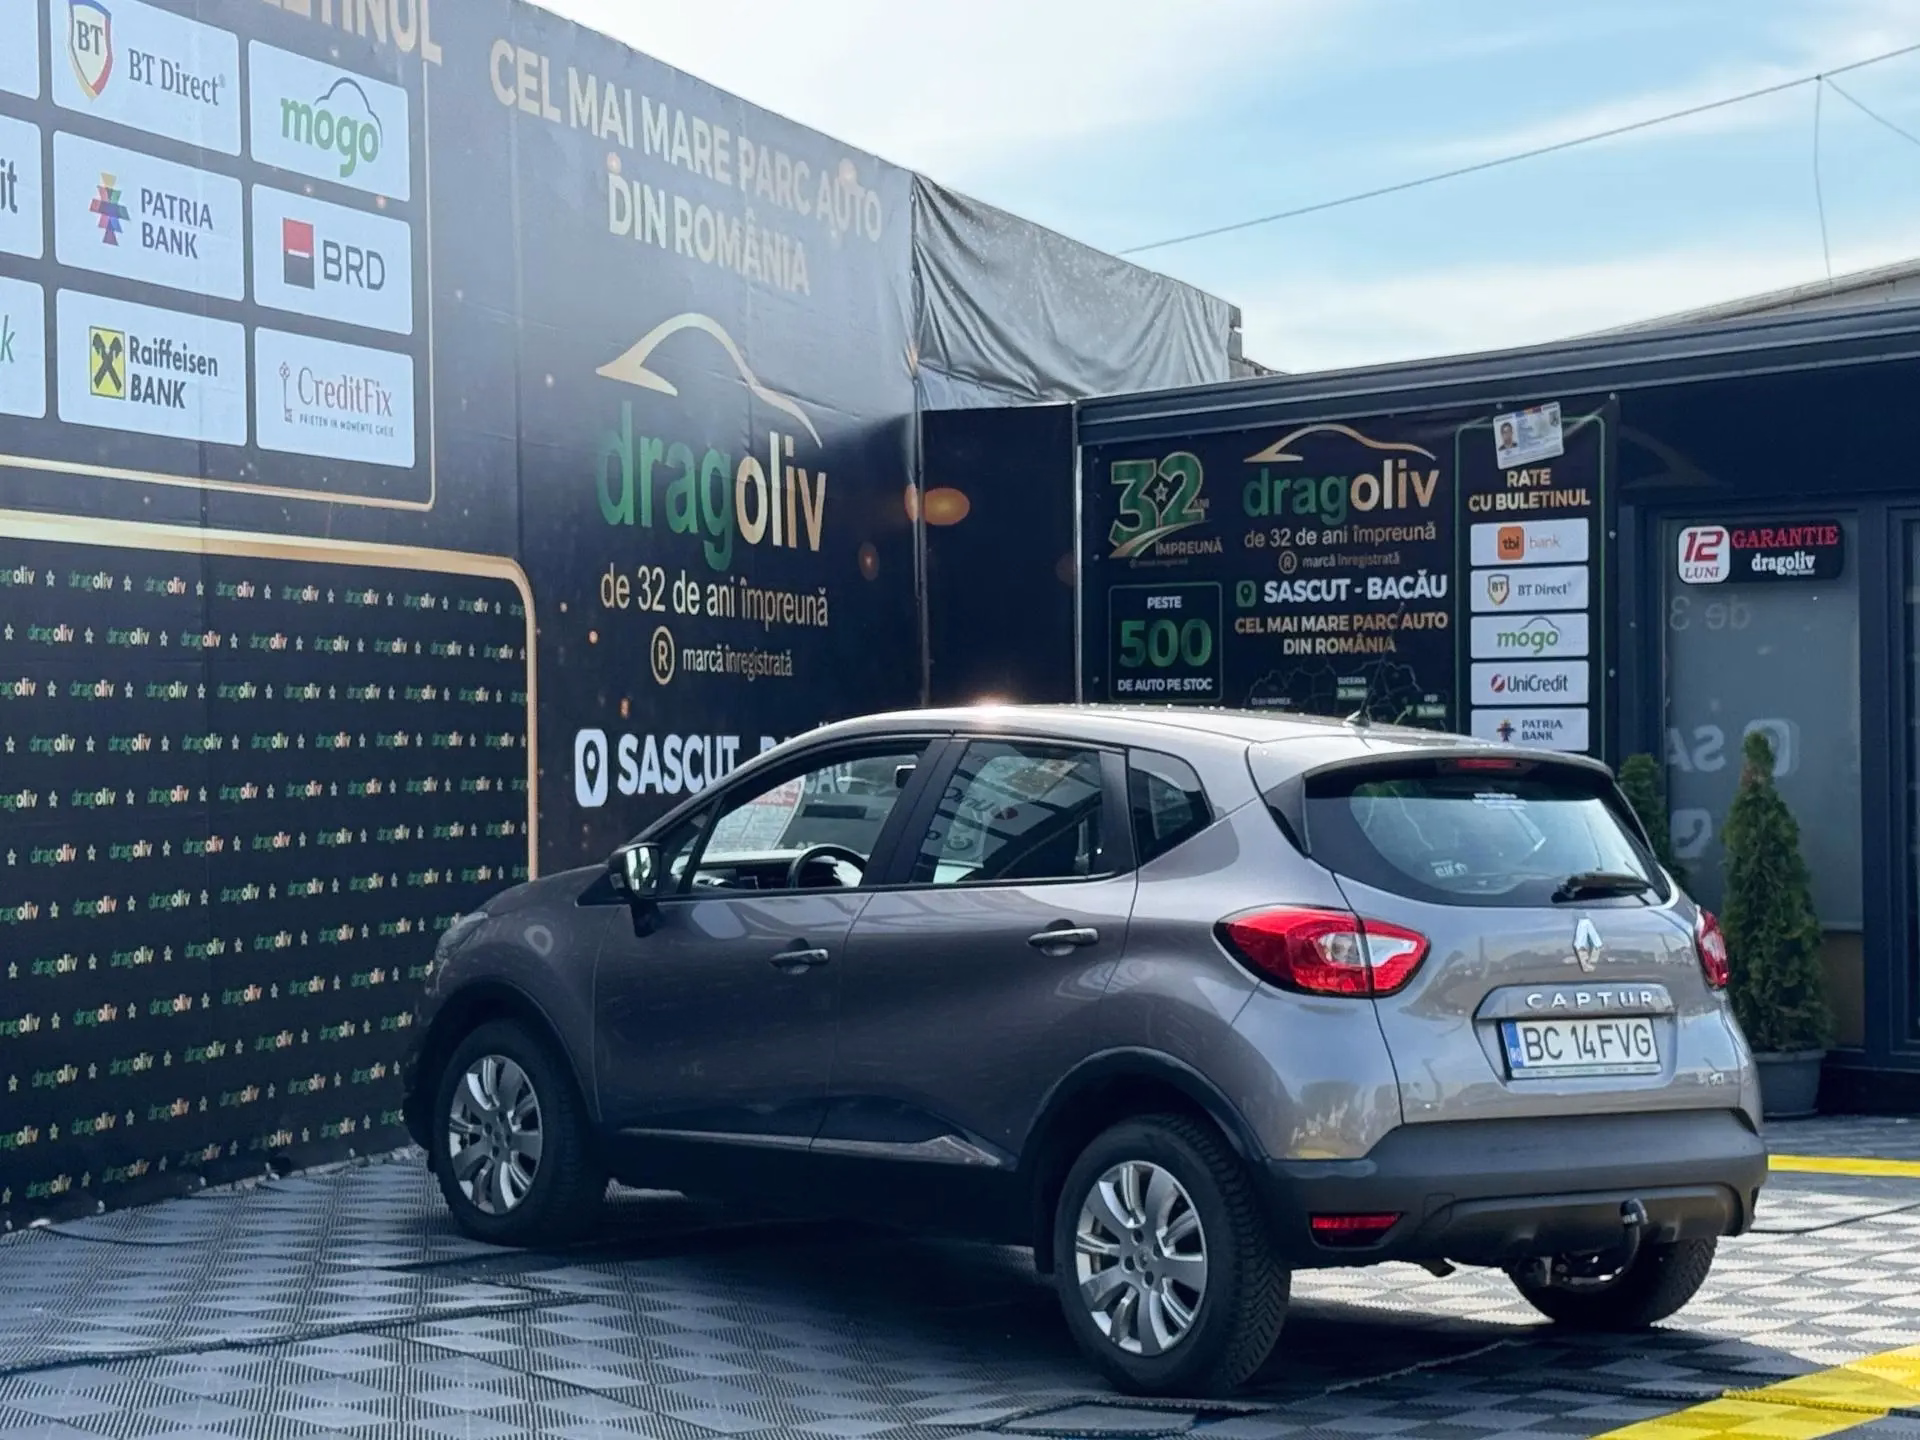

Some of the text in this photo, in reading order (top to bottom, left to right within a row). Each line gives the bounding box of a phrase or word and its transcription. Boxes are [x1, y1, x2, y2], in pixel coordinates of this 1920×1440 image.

[76, 20, 104, 55] BT
[128, 48, 155, 86] BT
[281, 97, 378, 178] mogo
[490, 39, 882, 243] CEL MAI MARE PARC AUTO
[140, 187, 213, 230] PATRIA
[141, 221, 198, 259] BANK
[608, 174, 811, 296] DIN ROMÂNIA
[322, 240, 385, 291] BRD
[129, 335, 218, 378] Raiffeisen
[130, 373, 187, 410] BANK
[297, 366, 392, 418] CreditFix
[597, 400, 827, 571] dragoliv
[1506, 468, 1552, 488] RATE
[1242, 459, 1440, 526] dragoliv
[1468, 488, 1592, 512] CU BULETINUL
[1244, 521, 1437, 548] de 32 de ani împreună
[1502, 536, 1520, 550] tbi
[1529, 534, 1562, 549] bank
[1684, 530, 1724, 563] 12
[1732, 526, 1839, 548] GARANTIE
[1685, 566, 1720, 579] LUNI
[1751, 551, 1816, 575] dragoliv
[70, 573, 113, 591] dragoliv
[1263, 578, 1351, 604] SASCUT
[1366, 569, 1448, 601] BACĂU
[1518, 584, 1533, 596] BT
[600, 562, 830, 632] de 32 de ani împreună
[1147, 595, 1182, 609] PESTE
[27, 625, 74, 645] dragoliv
[1234, 611, 1449, 634] CEL MAI MARE PARC AUTO
[1119, 618, 1212, 667] 500
[1283, 632, 1397, 655] DIN ROMÂNIA
[1497, 629, 1560, 655] mogo
[682, 643, 724, 673] marcă
[725, 645, 794, 682] înregistrată
[69, 680, 114, 700] dragoliv
[145, 682, 188, 701] dragoliv
[1117, 677, 1213, 691] DE AUTO PE STOC
[1507, 674, 1569, 692] UniCredit
[1522, 719, 1563, 730] PATRIA
[1522, 731, 1554, 741] BANK
[29, 735, 75, 756] dragoliv
[71, 789, 116, 809] dragoliv
[29, 845, 76, 866] dragoliv
[109, 841, 152, 862] dragoliv
[73, 896, 117, 917] dragoliv
[31, 955, 78, 977] dragoliv
[111, 947, 154, 968] dragoliv
[73, 1005, 117, 1028] dragoliv
[149, 995, 192, 1016] dragoliv
[1526, 991, 1655, 1010] CAPTUR
[1522, 1024, 1564, 1062] BC
[1570, 1022, 1652, 1060] 14FVG
[33, 1065, 78, 1088] dragoliv
[73, 1113, 116, 1136] dragoliv
[27, 1175, 72, 1198] dragoliv
[103, 1160, 149, 1182] dragoliv
